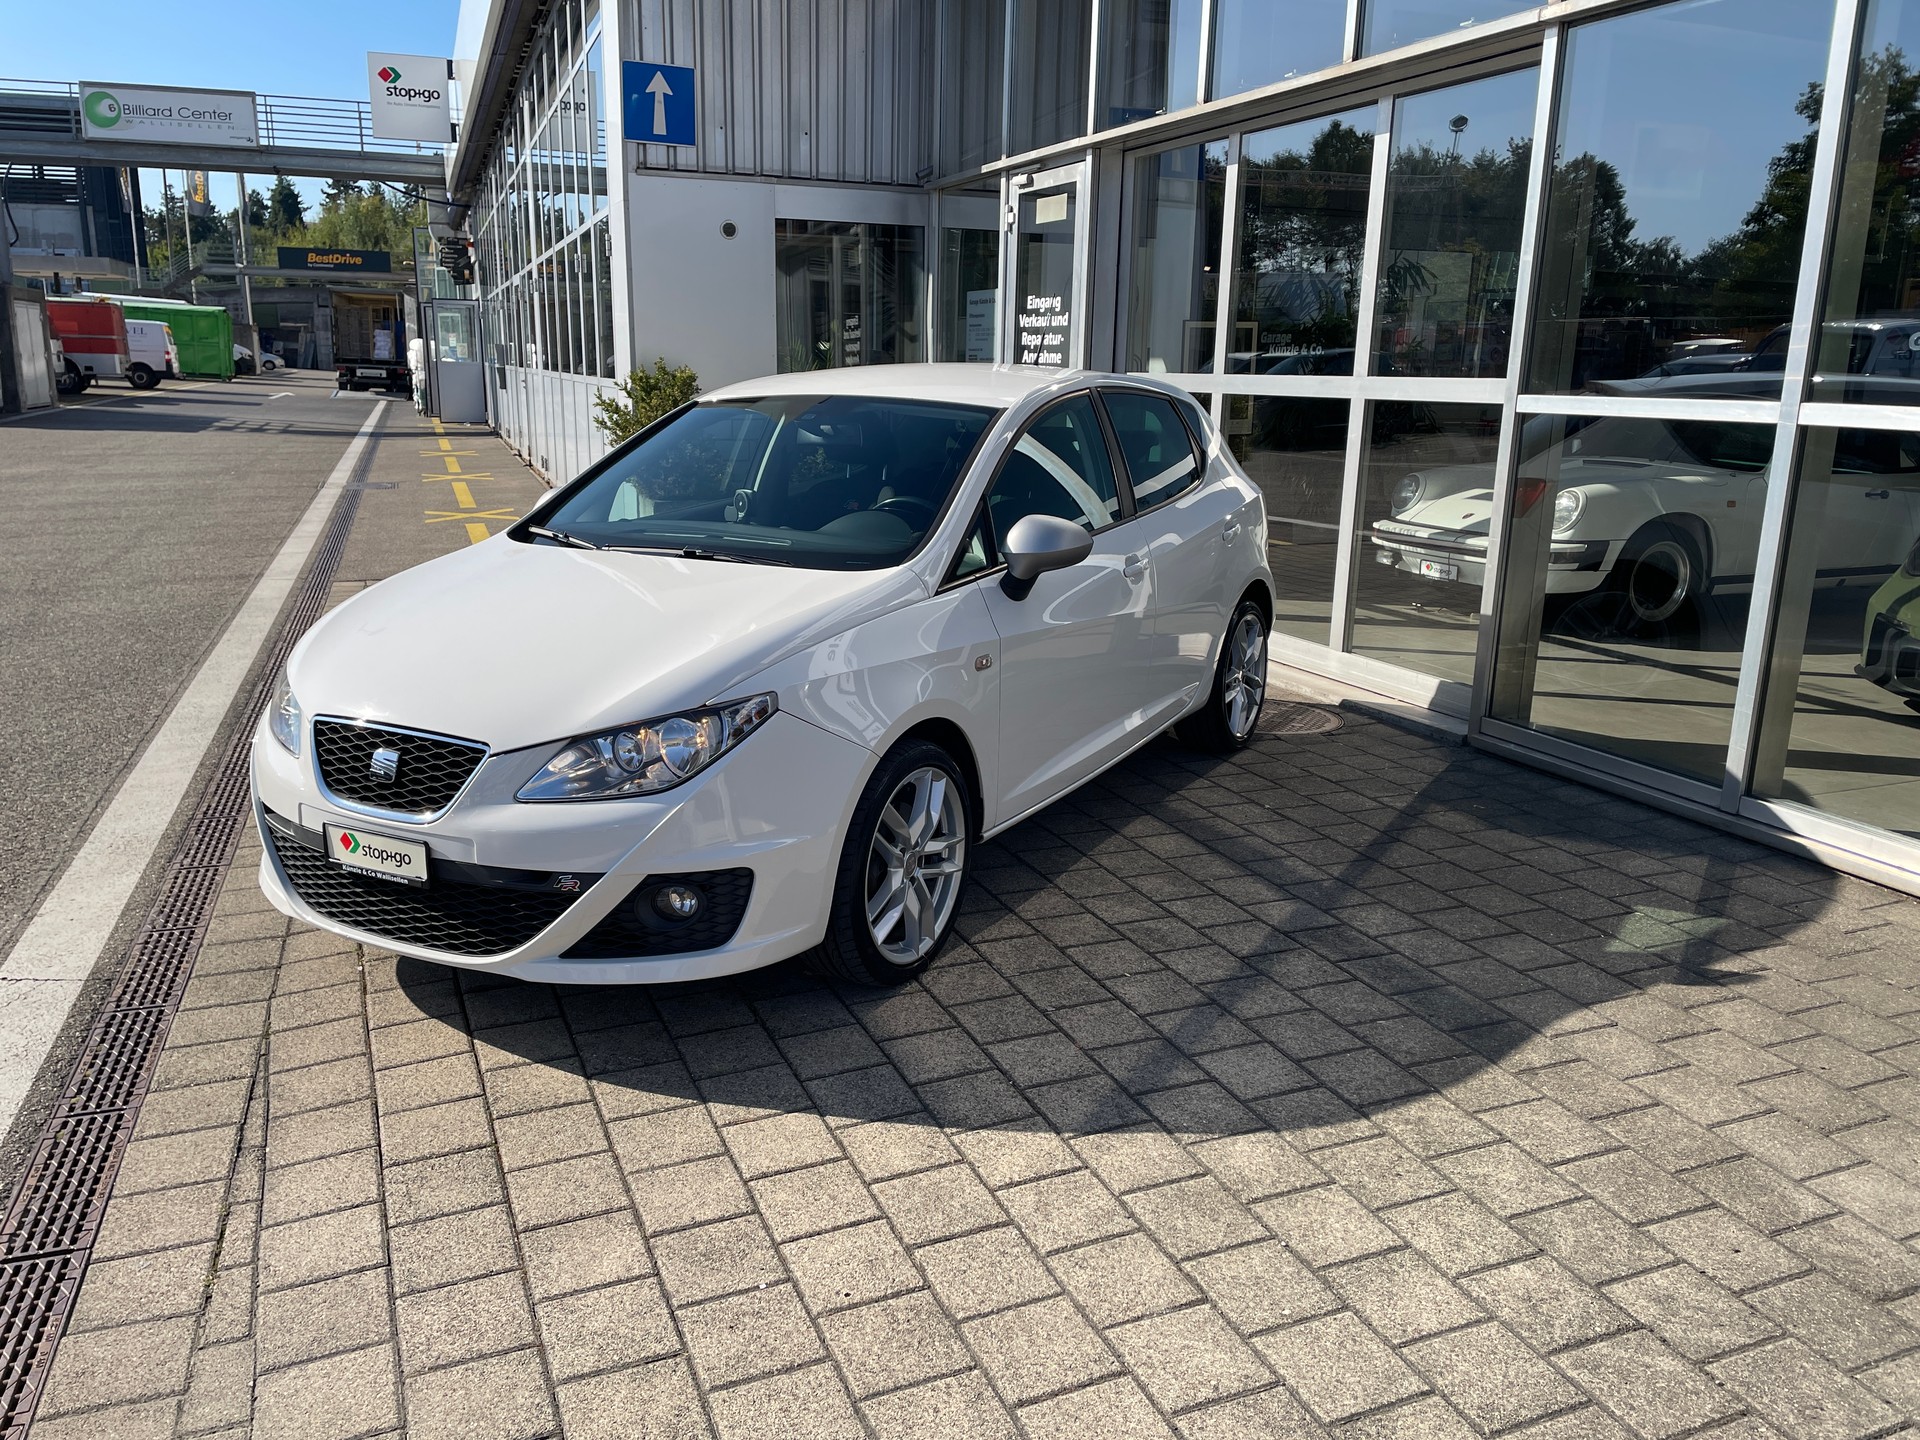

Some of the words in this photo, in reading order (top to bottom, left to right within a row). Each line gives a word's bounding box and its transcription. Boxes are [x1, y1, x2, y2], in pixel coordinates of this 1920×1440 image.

[386, 85, 441, 102] stop+go
[123, 104, 172, 117] Billiard
[177, 106, 233, 121] Center
[124, 119, 235, 131] WALLISELLEN
[195, 170, 204, 203] BestD
[307, 253, 363, 265] BestDrive
[1027, 295, 1061, 312] Eingang
[1019, 313, 1051, 327] Verkauf
[1051, 312, 1069, 326] und
[1021, 332, 1064, 349] Repaatur-
[1261, 332, 1292, 346] Garage
[1268, 343, 1299, 355] Künzle
[1300, 344, 1308, 355] &
[1309, 343, 1325, 355] Co.
[361, 844, 412, 867] stop+go
[342, 864, 362, 874] Künzle
[376, 872, 409, 885] Wallisellen
